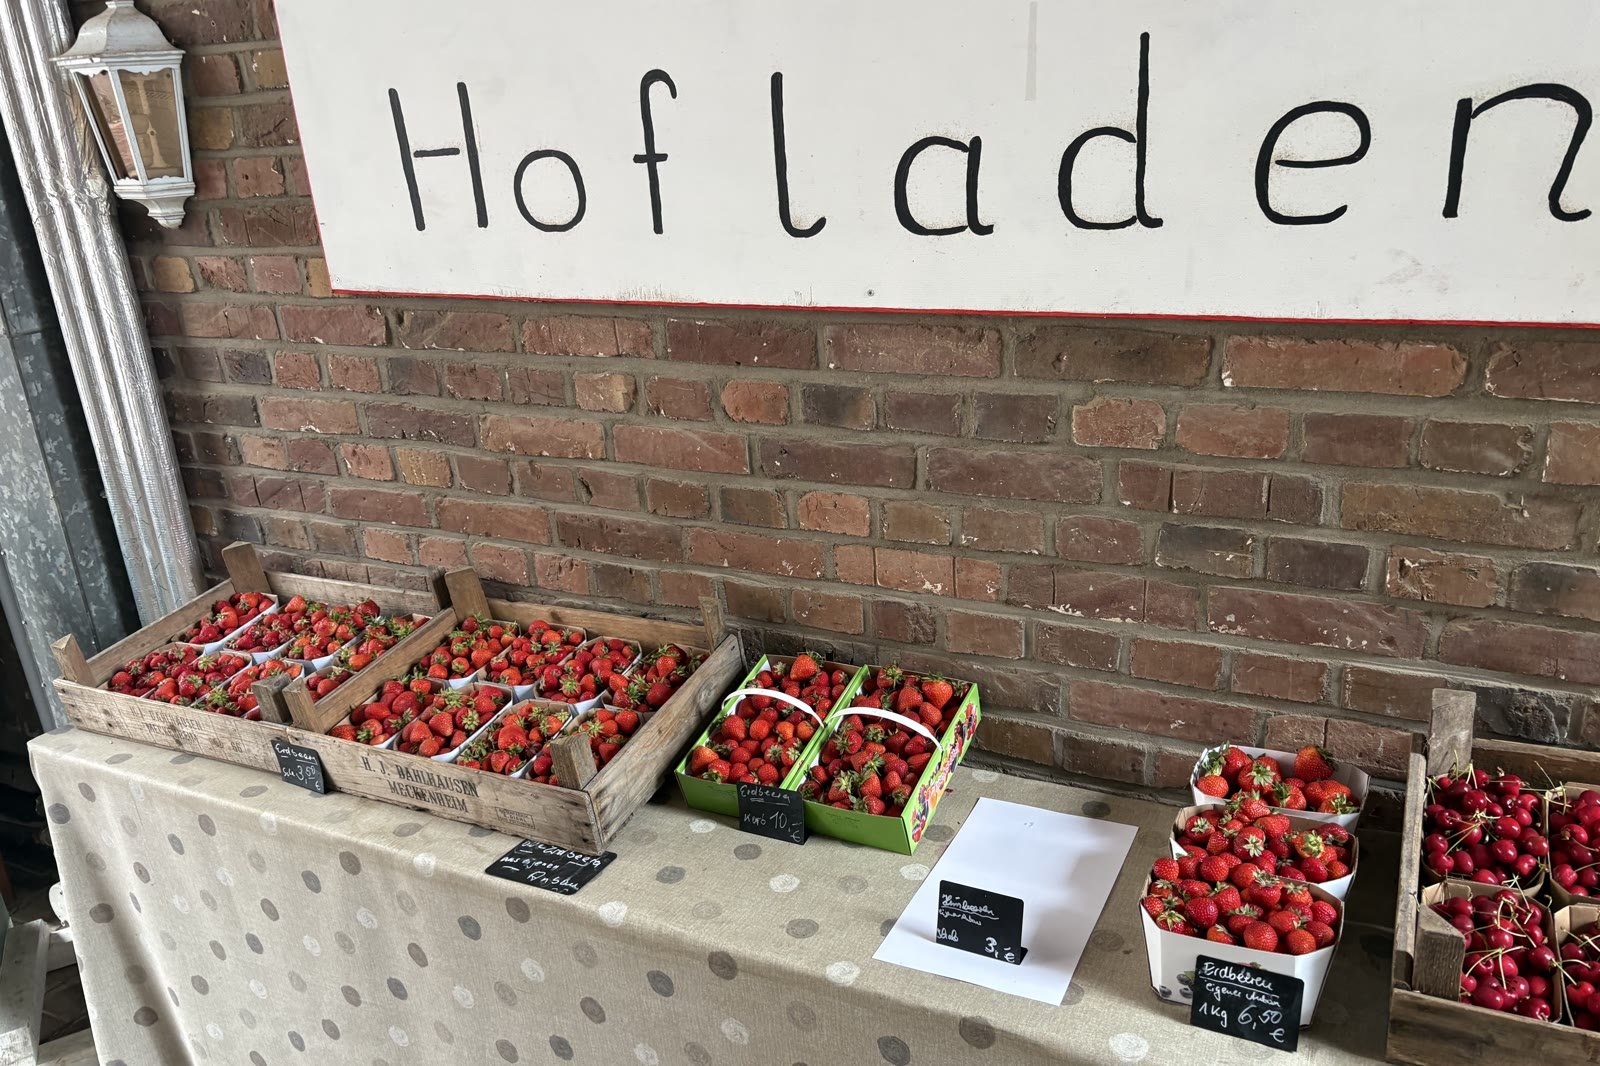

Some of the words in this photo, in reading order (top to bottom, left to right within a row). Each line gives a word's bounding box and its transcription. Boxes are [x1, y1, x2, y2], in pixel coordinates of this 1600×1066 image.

[388, 31, 1593, 239] Hofladen
[361, 756, 376, 773] H.
[379, 760, 391, 777] J.
[396, 764, 480, 798] DAHLHAUSEN
[387, 780, 469, 813] MECKENHEIM
[1203, 961, 1274, 991] Erdbeeren
[1237, 1004, 1283, 1030] 6,50
[1268, 1027, 1285, 1043] €
